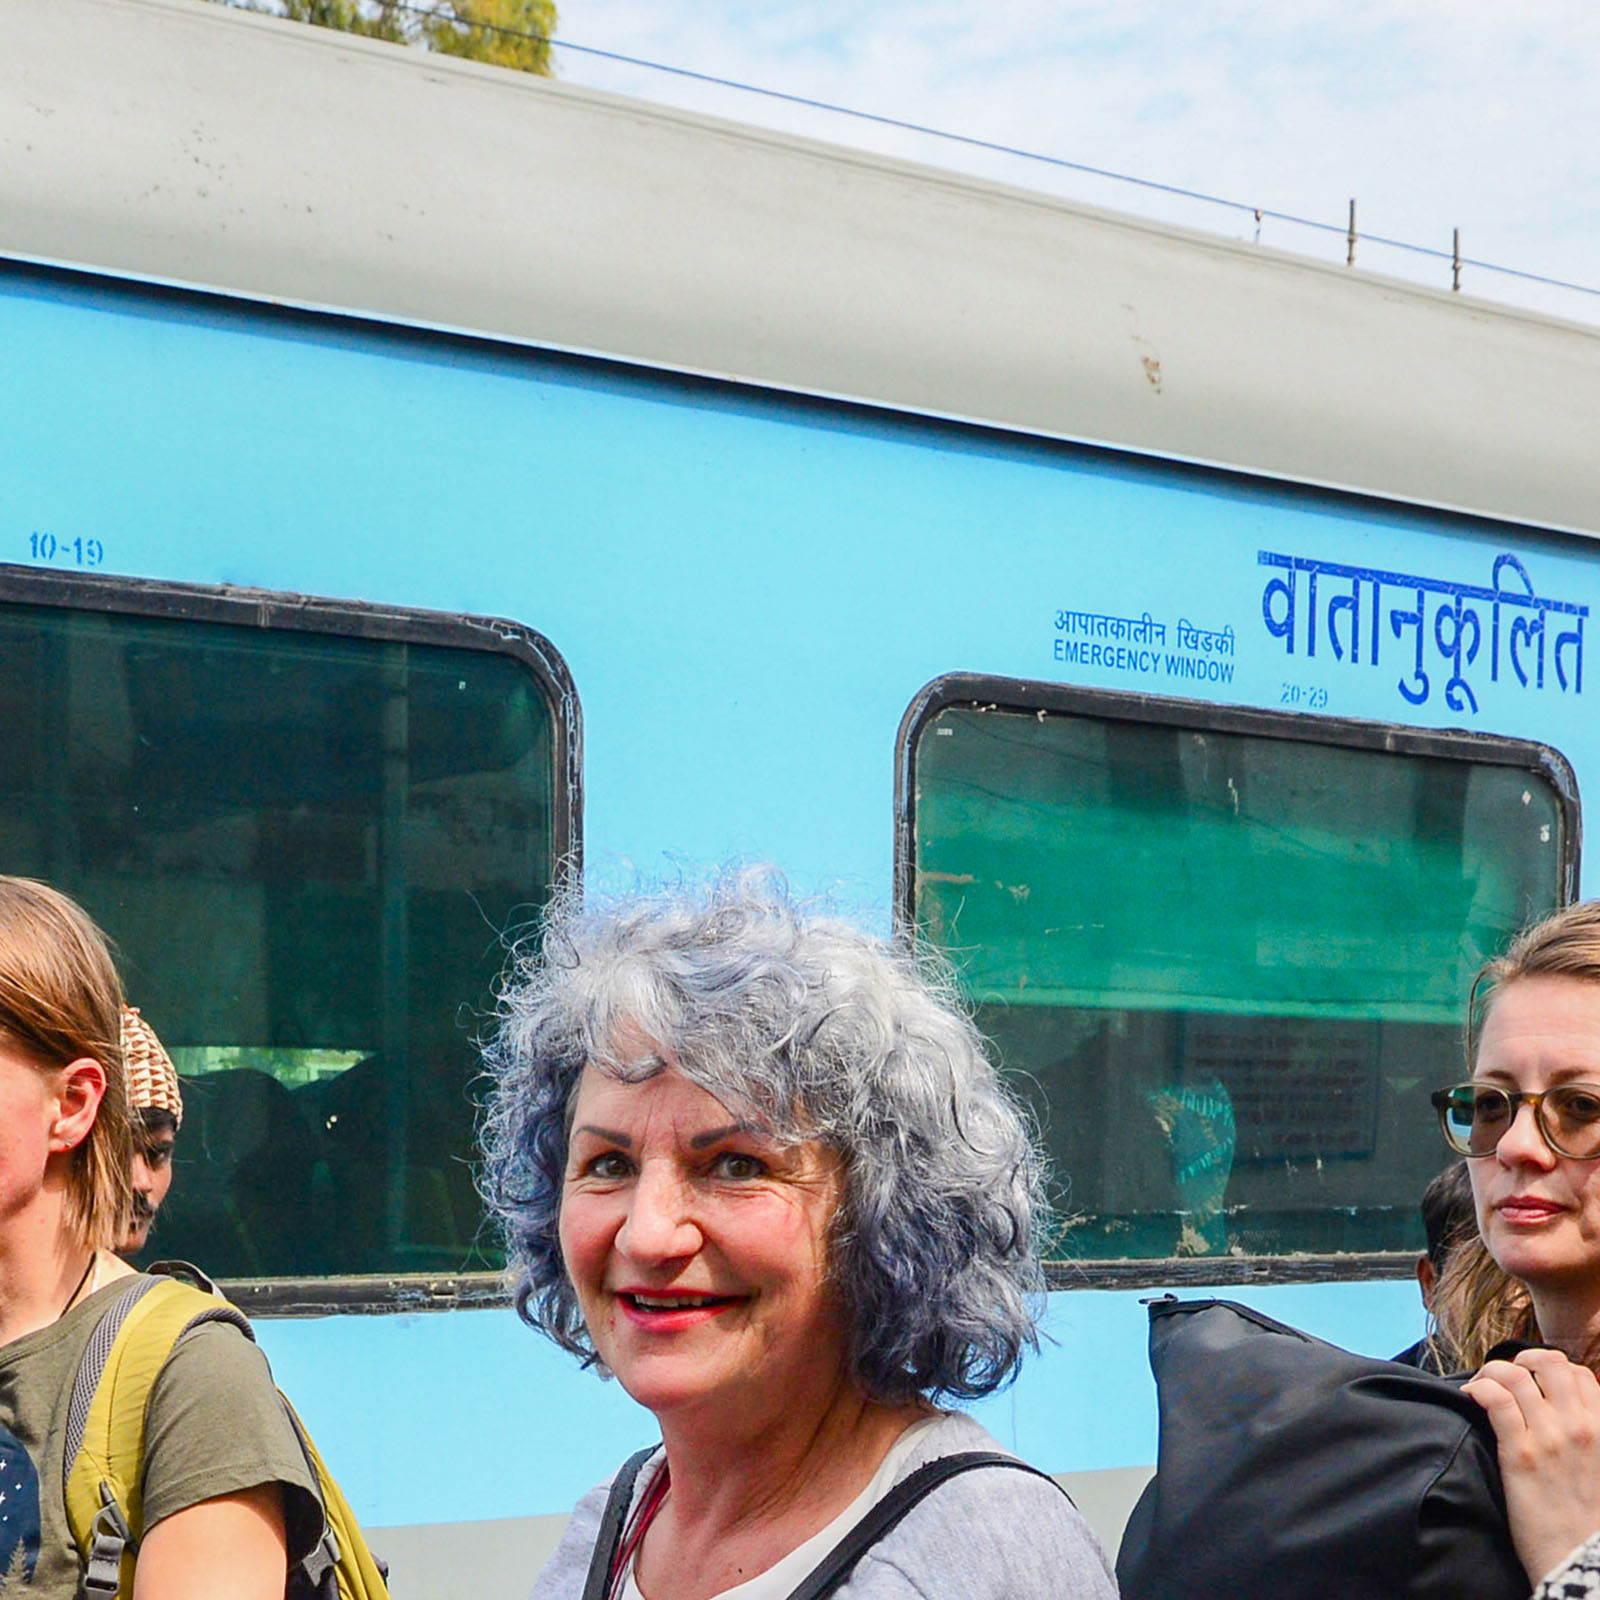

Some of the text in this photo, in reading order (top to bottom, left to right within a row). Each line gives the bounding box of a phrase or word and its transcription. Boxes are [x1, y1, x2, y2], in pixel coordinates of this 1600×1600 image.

[29, 530, 104, 566] 10-19
[1053, 610, 1236, 658] आपातकालीन खिड़की
[1257, 550, 1590, 716] वातानुकूलित
[1053, 638, 1235, 685] EMERGENCY WINDOW
[1280, 681, 1329, 709] 20-29
